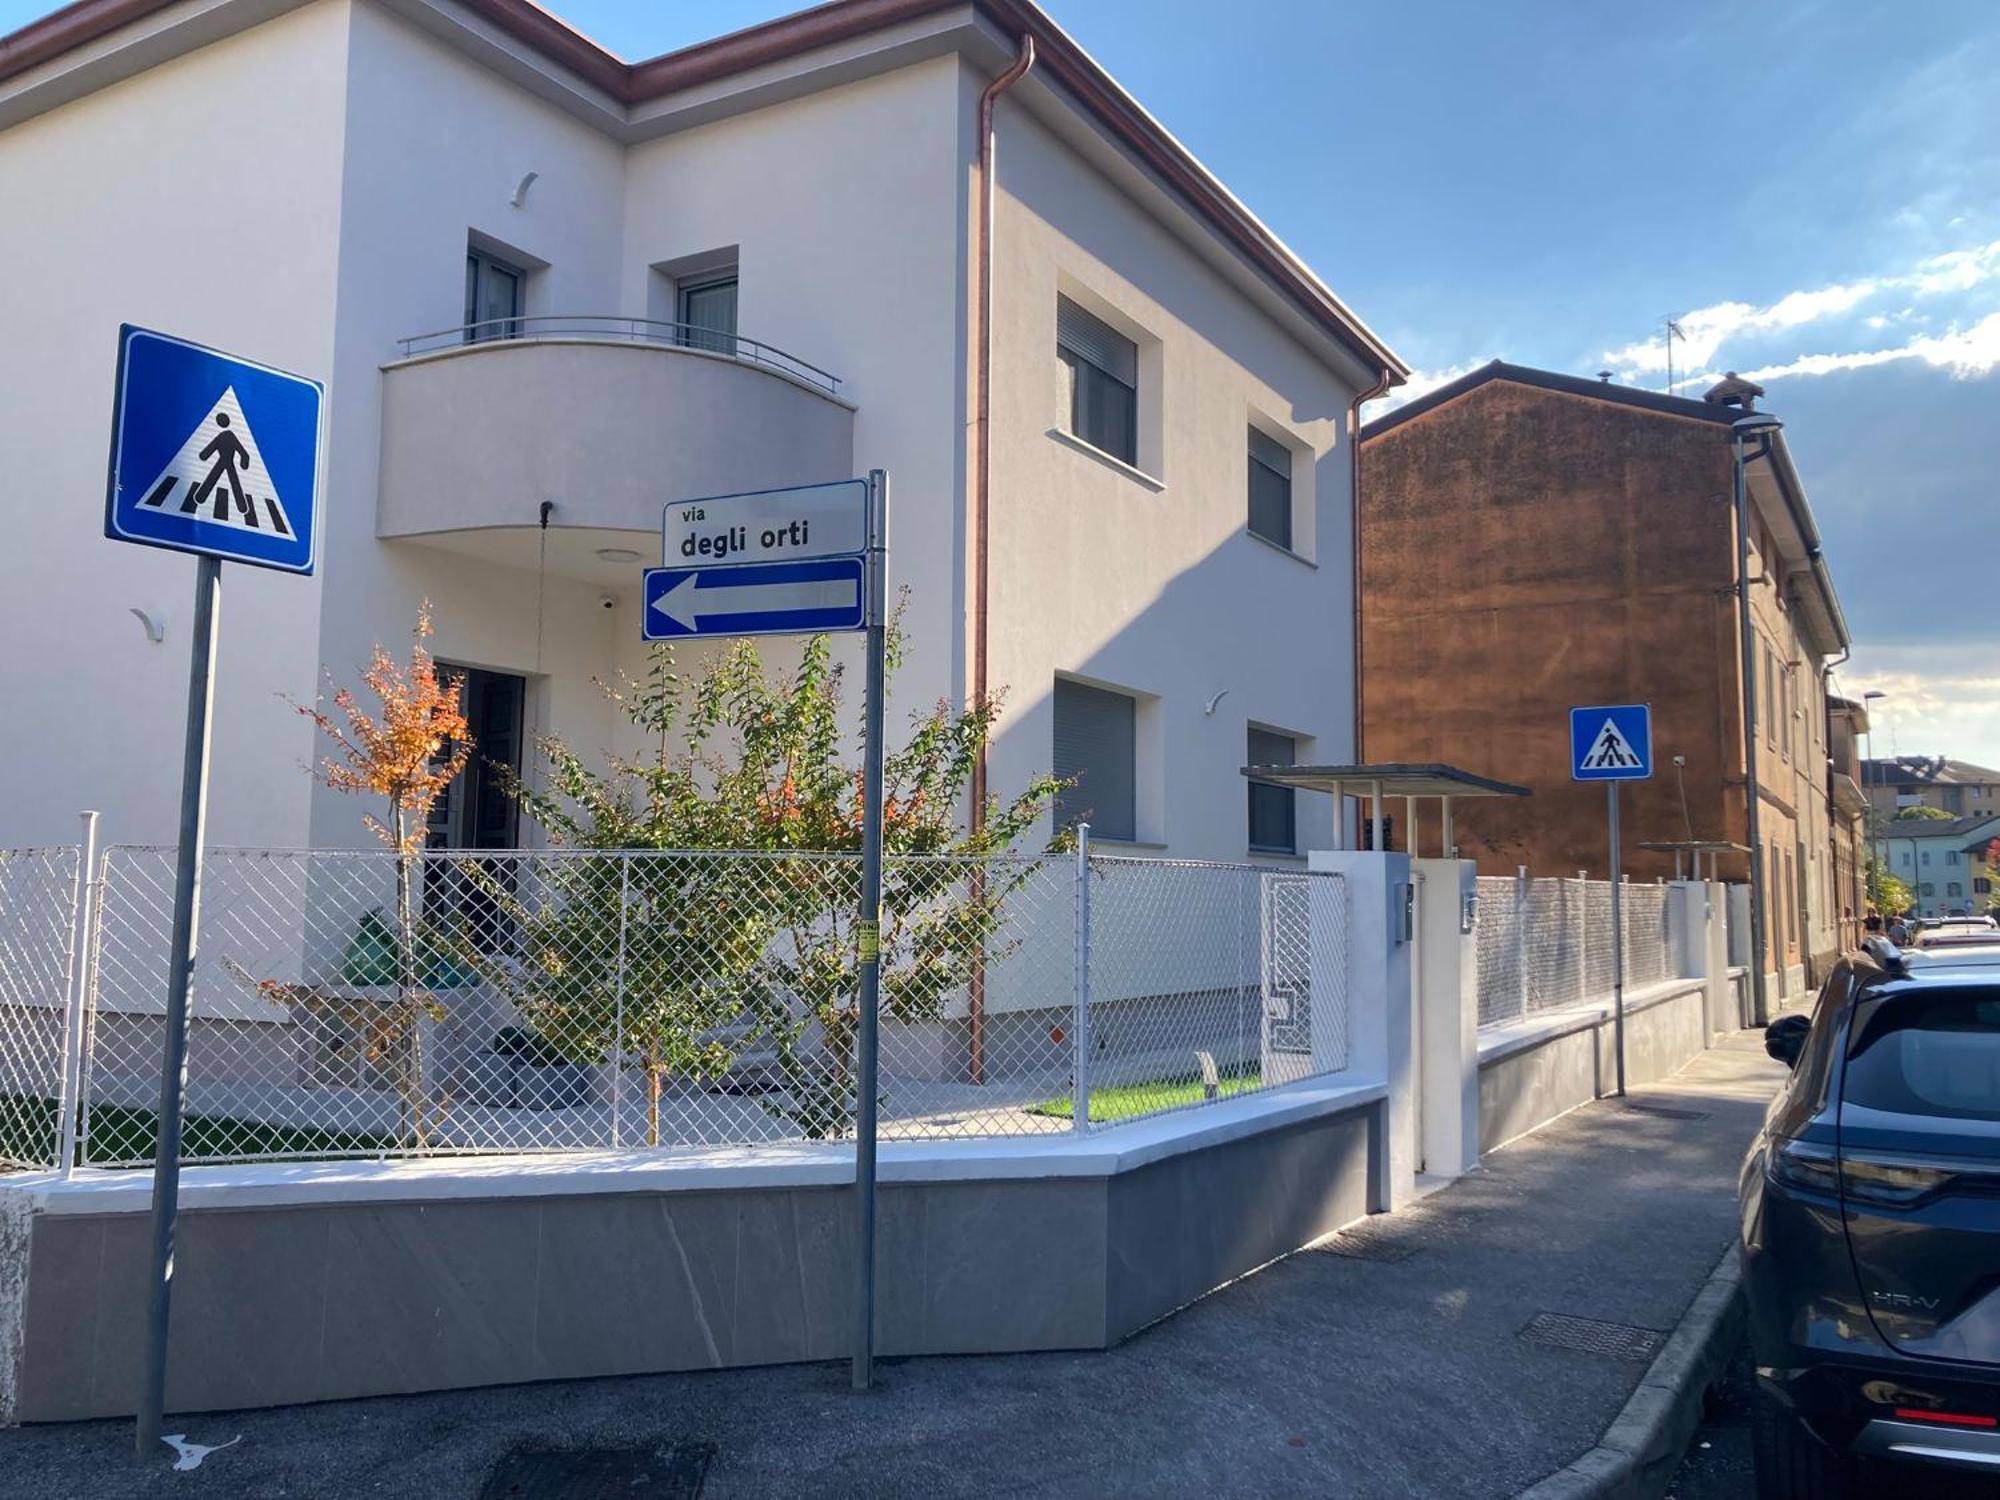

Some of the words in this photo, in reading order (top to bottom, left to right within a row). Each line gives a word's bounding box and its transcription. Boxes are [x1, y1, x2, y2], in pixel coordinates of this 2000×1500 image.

[682, 506, 705, 522] via
[681, 526, 746, 558] degli
[760, 520, 809, 548] orti
[1872, 1291, 1940, 1310] HR-V
